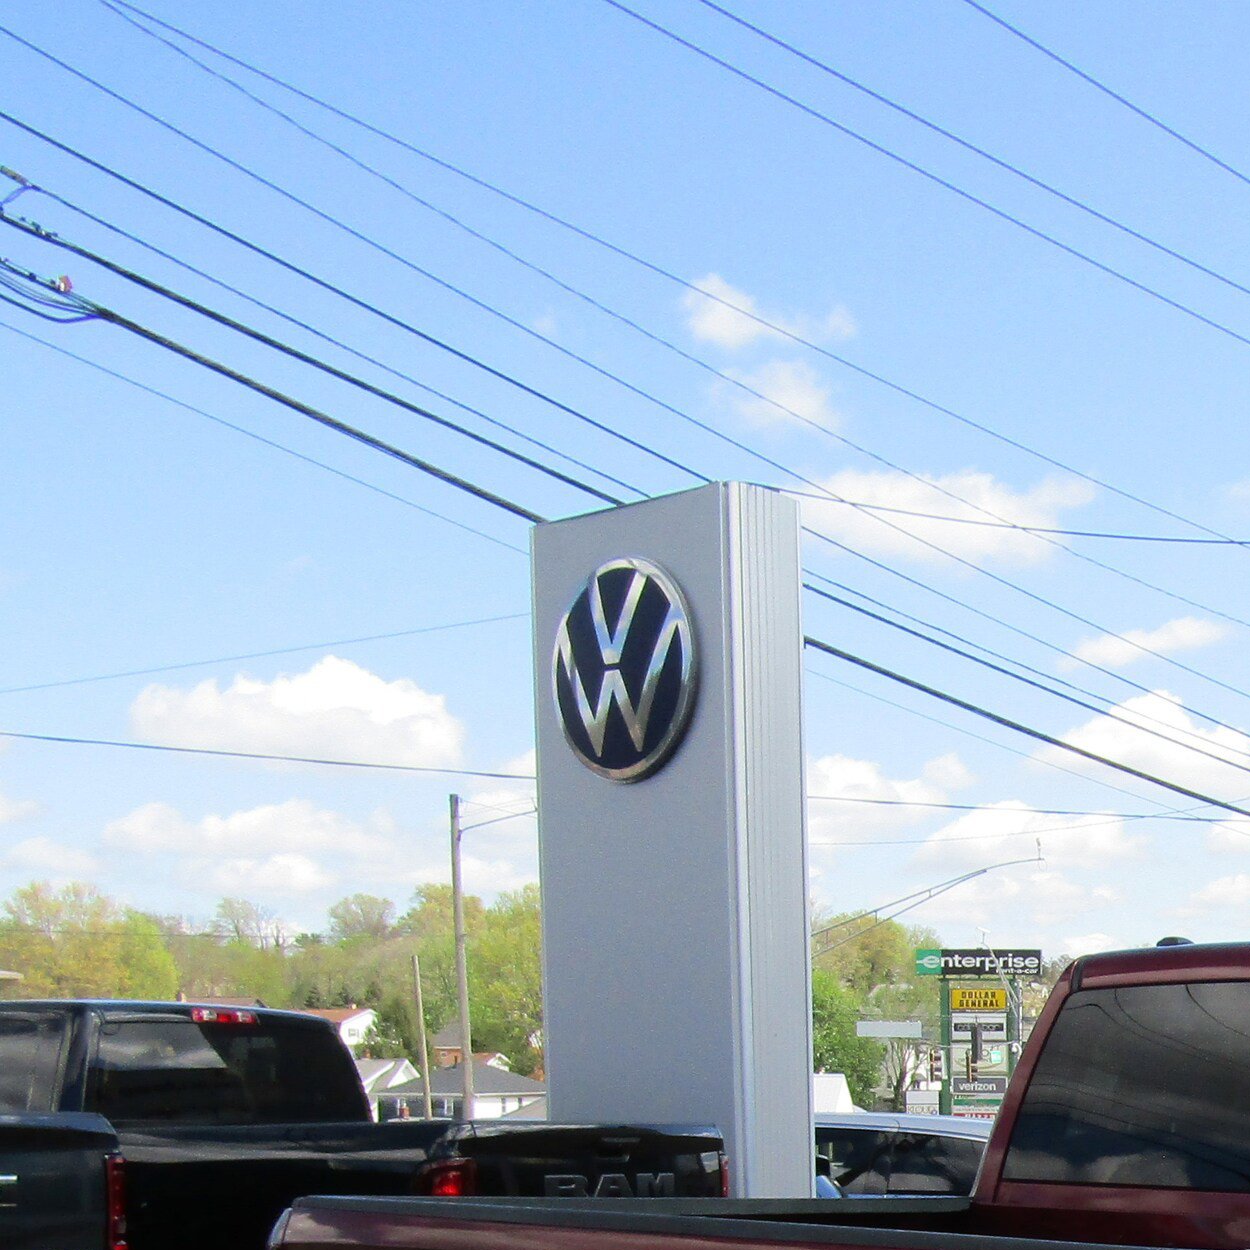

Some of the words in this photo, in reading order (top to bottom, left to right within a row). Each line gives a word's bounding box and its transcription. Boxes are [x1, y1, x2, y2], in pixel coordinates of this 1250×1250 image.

[917, 953, 1039, 971] enterprise
[961, 991, 996, 999] DOLLAR
[959, 999, 999, 1008] GENERAL
[958, 1081, 997, 1091] verizon
[544, 1172, 676, 1198] RAM
